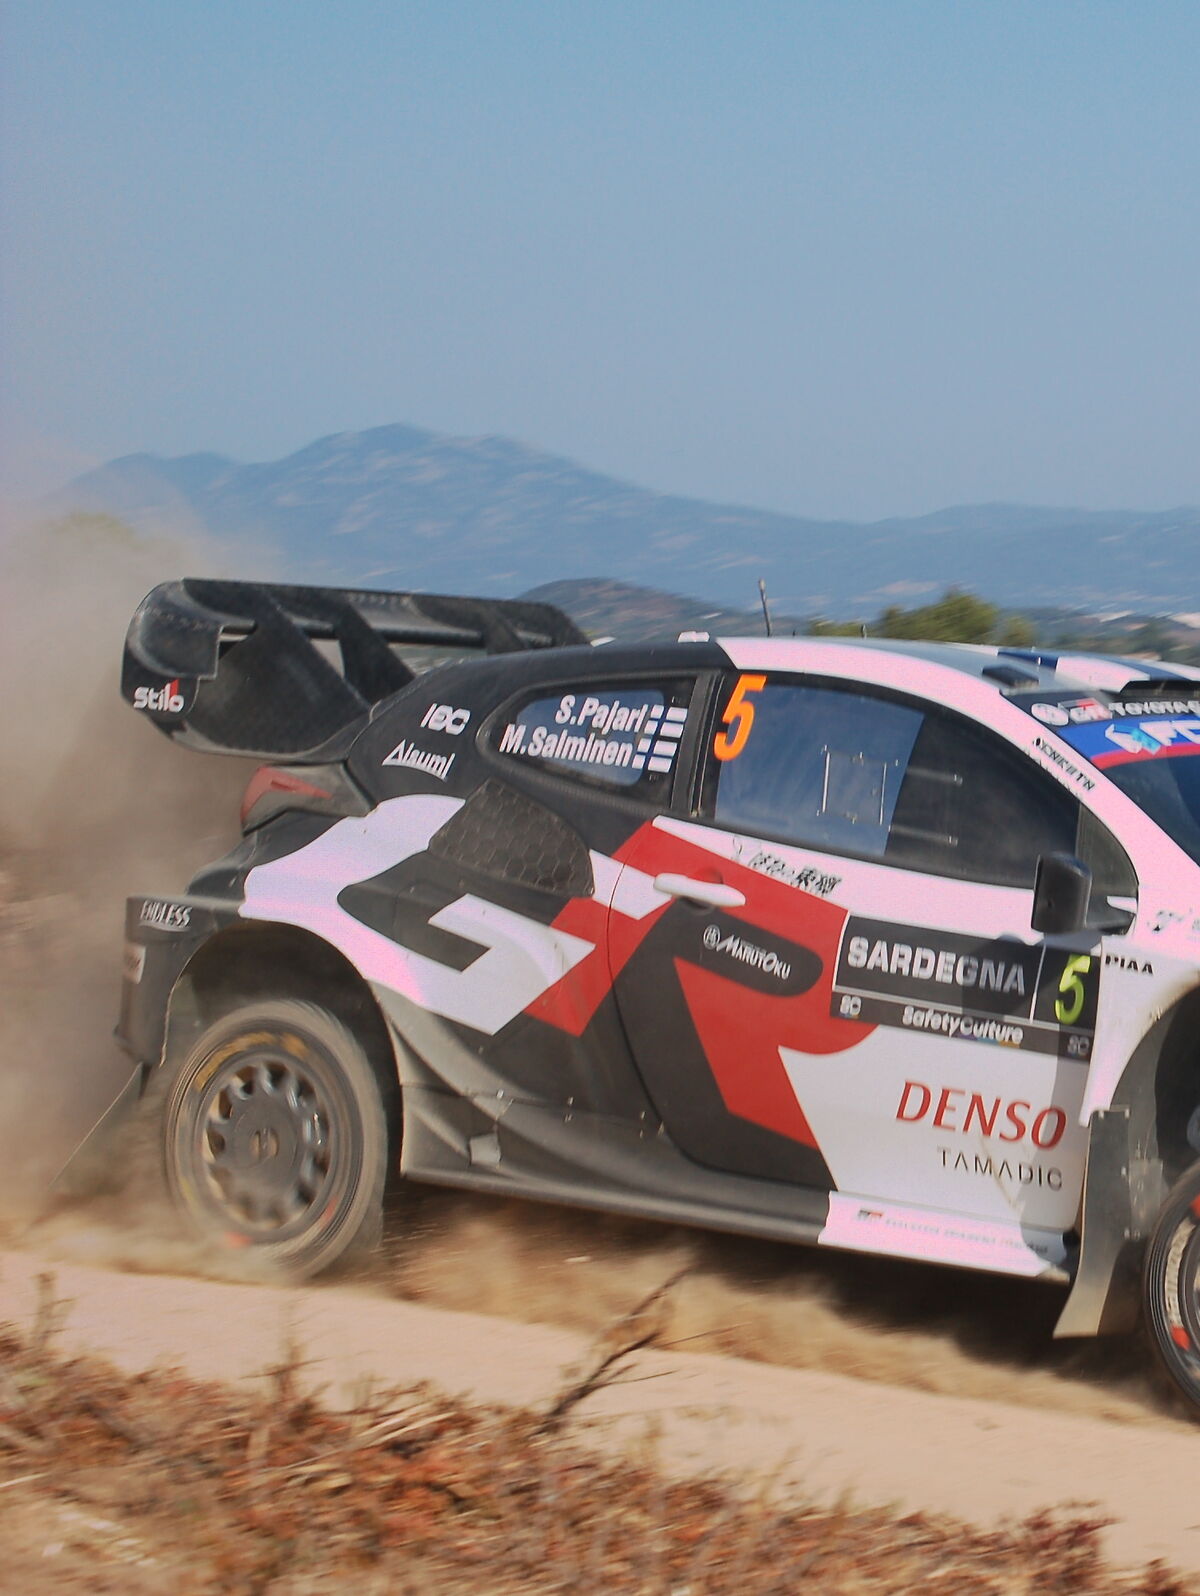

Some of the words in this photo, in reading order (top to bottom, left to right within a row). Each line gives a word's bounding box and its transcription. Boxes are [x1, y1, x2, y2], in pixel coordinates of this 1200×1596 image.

[713, 674, 768, 762] 5
[847, 936, 1026, 996] SARDEGNA
[1054, 955, 1091, 1025] 5
[1105, 954, 1154, 975] PIAA
[895, 1080, 1068, 1151] DENSO
